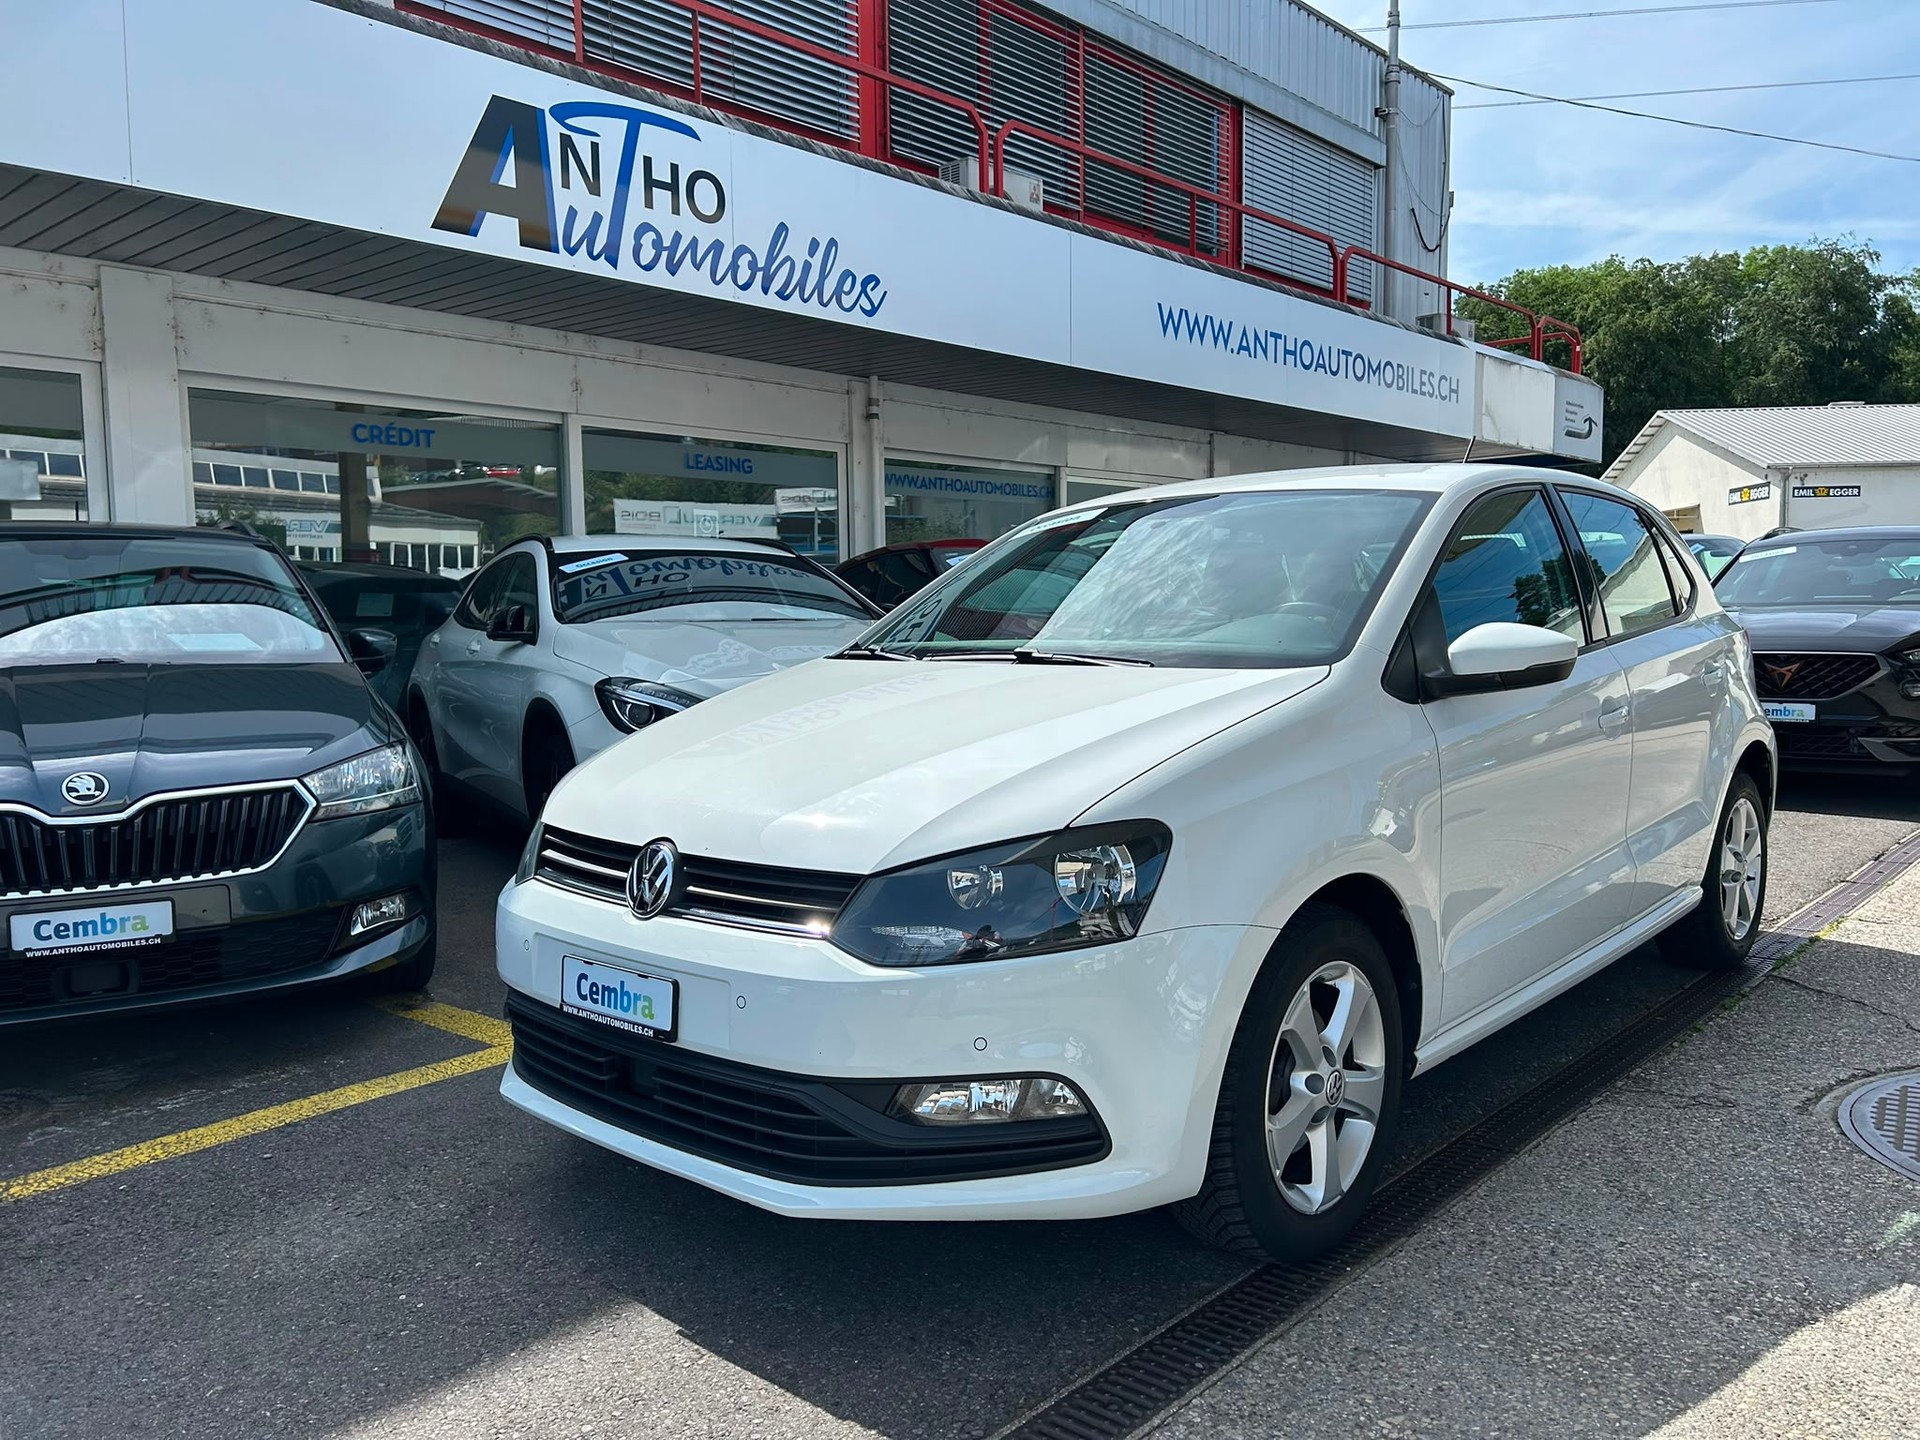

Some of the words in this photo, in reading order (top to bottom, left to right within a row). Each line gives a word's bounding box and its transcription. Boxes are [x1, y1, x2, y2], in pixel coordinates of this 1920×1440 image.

[430, 93, 727, 269] ANTHO
[1156, 301, 1461, 404] WWW.ANTHOAUTOMOBILES.CH
[352, 422, 436, 449] CRÉDIT
[685, 452, 754, 474] LEASING
[1729, 491, 1742, 504] EMIL
[1750, 486, 1770, 501] EGGER
[1794, 488, 1815, 497] EMIL
[1829, 487, 1860, 497] EGGER
[1763, 706, 1805, 718] embra
[33, 912, 149, 941] Cembra
[25, 937, 162, 958] WWW.ANTHOAUTOMOBILES.CH
[576, 972, 655, 1020] Cembra
[562, 1004, 655, 1038] WWW.ANTHOAUTOMOBILES.CH
